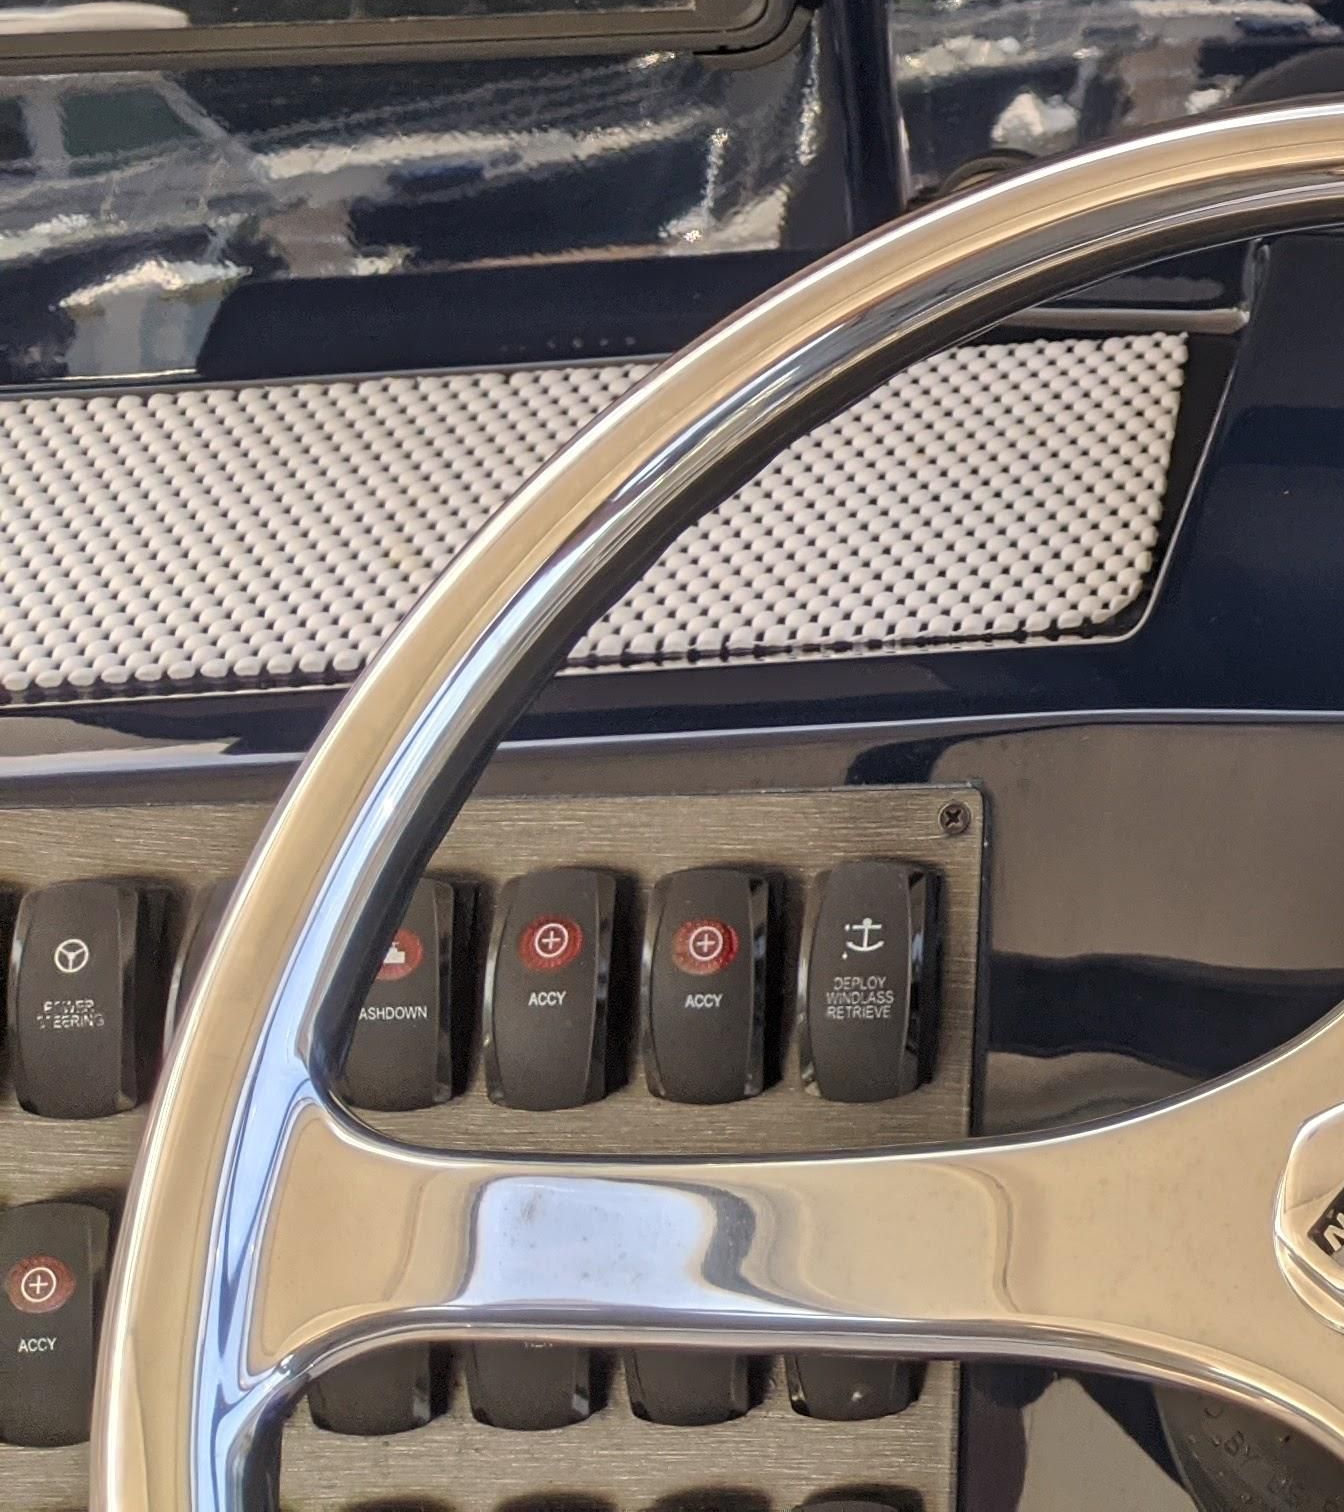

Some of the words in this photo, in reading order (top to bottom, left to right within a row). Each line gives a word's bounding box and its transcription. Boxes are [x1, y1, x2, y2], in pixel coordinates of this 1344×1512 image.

[833, 976, 887, 991] DEPLOY
[528, 991, 568, 1007] ACCY
[685, 993, 723, 1009] ACCY
[826, 990, 895, 1006] WINDLASS
[359, 1005, 428, 1021] ASHDOWN
[826, 1004, 892, 1020] RETRIEVE
[18, 1337, 58, 1354] ACCY
